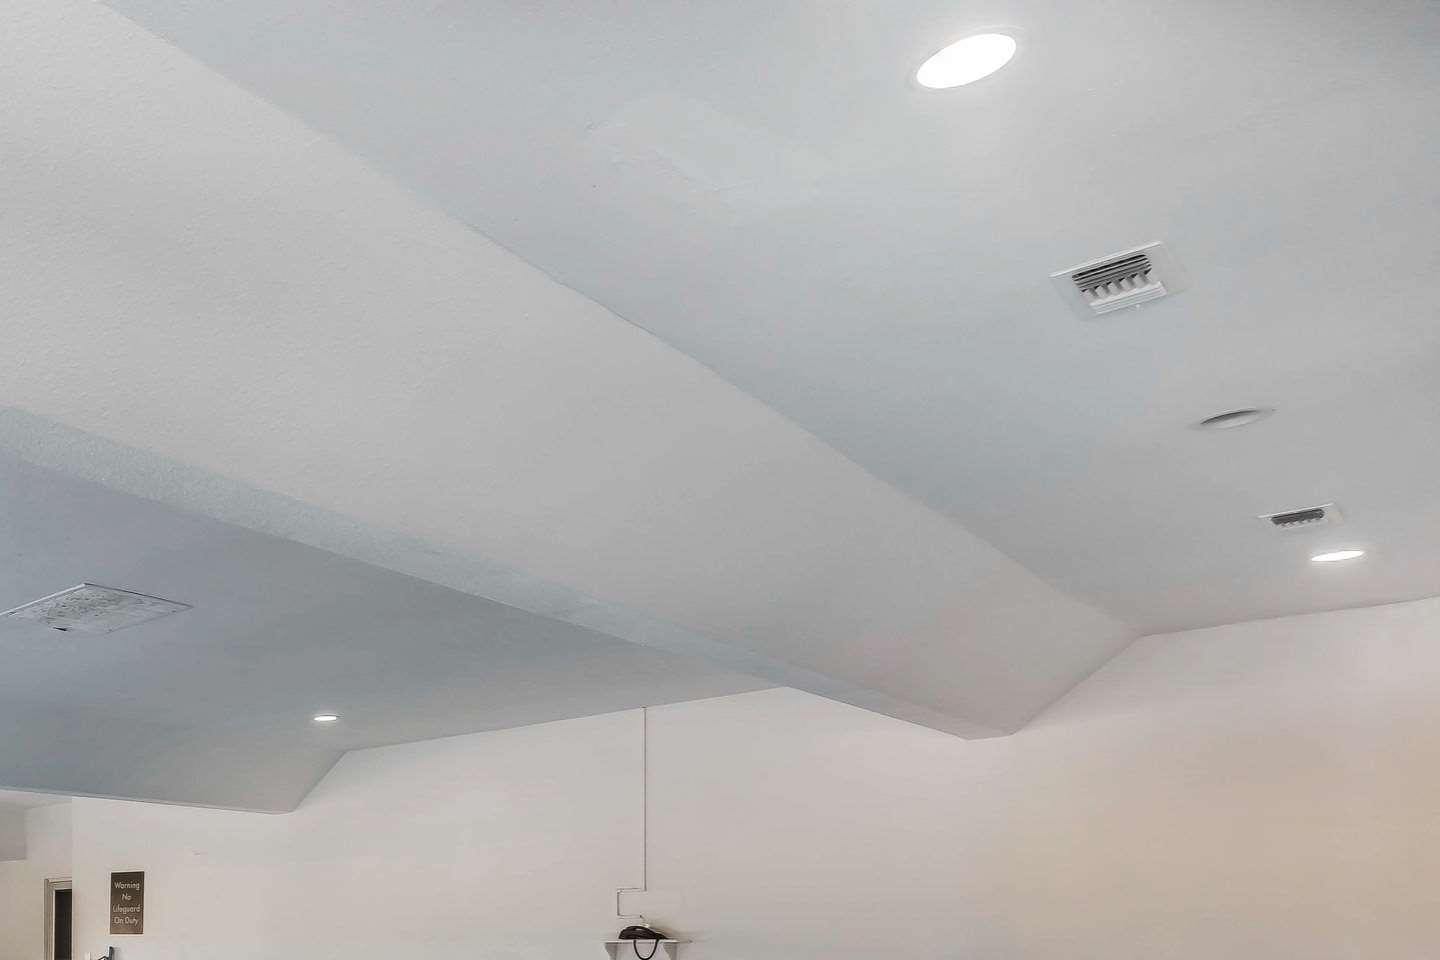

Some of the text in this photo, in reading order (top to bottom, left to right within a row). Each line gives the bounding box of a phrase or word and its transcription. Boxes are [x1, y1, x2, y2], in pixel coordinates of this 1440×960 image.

[114, 882, 140, 890] Warning
[112, 904, 141, 914] Lifeguard
[125, 917, 138, 926] Duty
